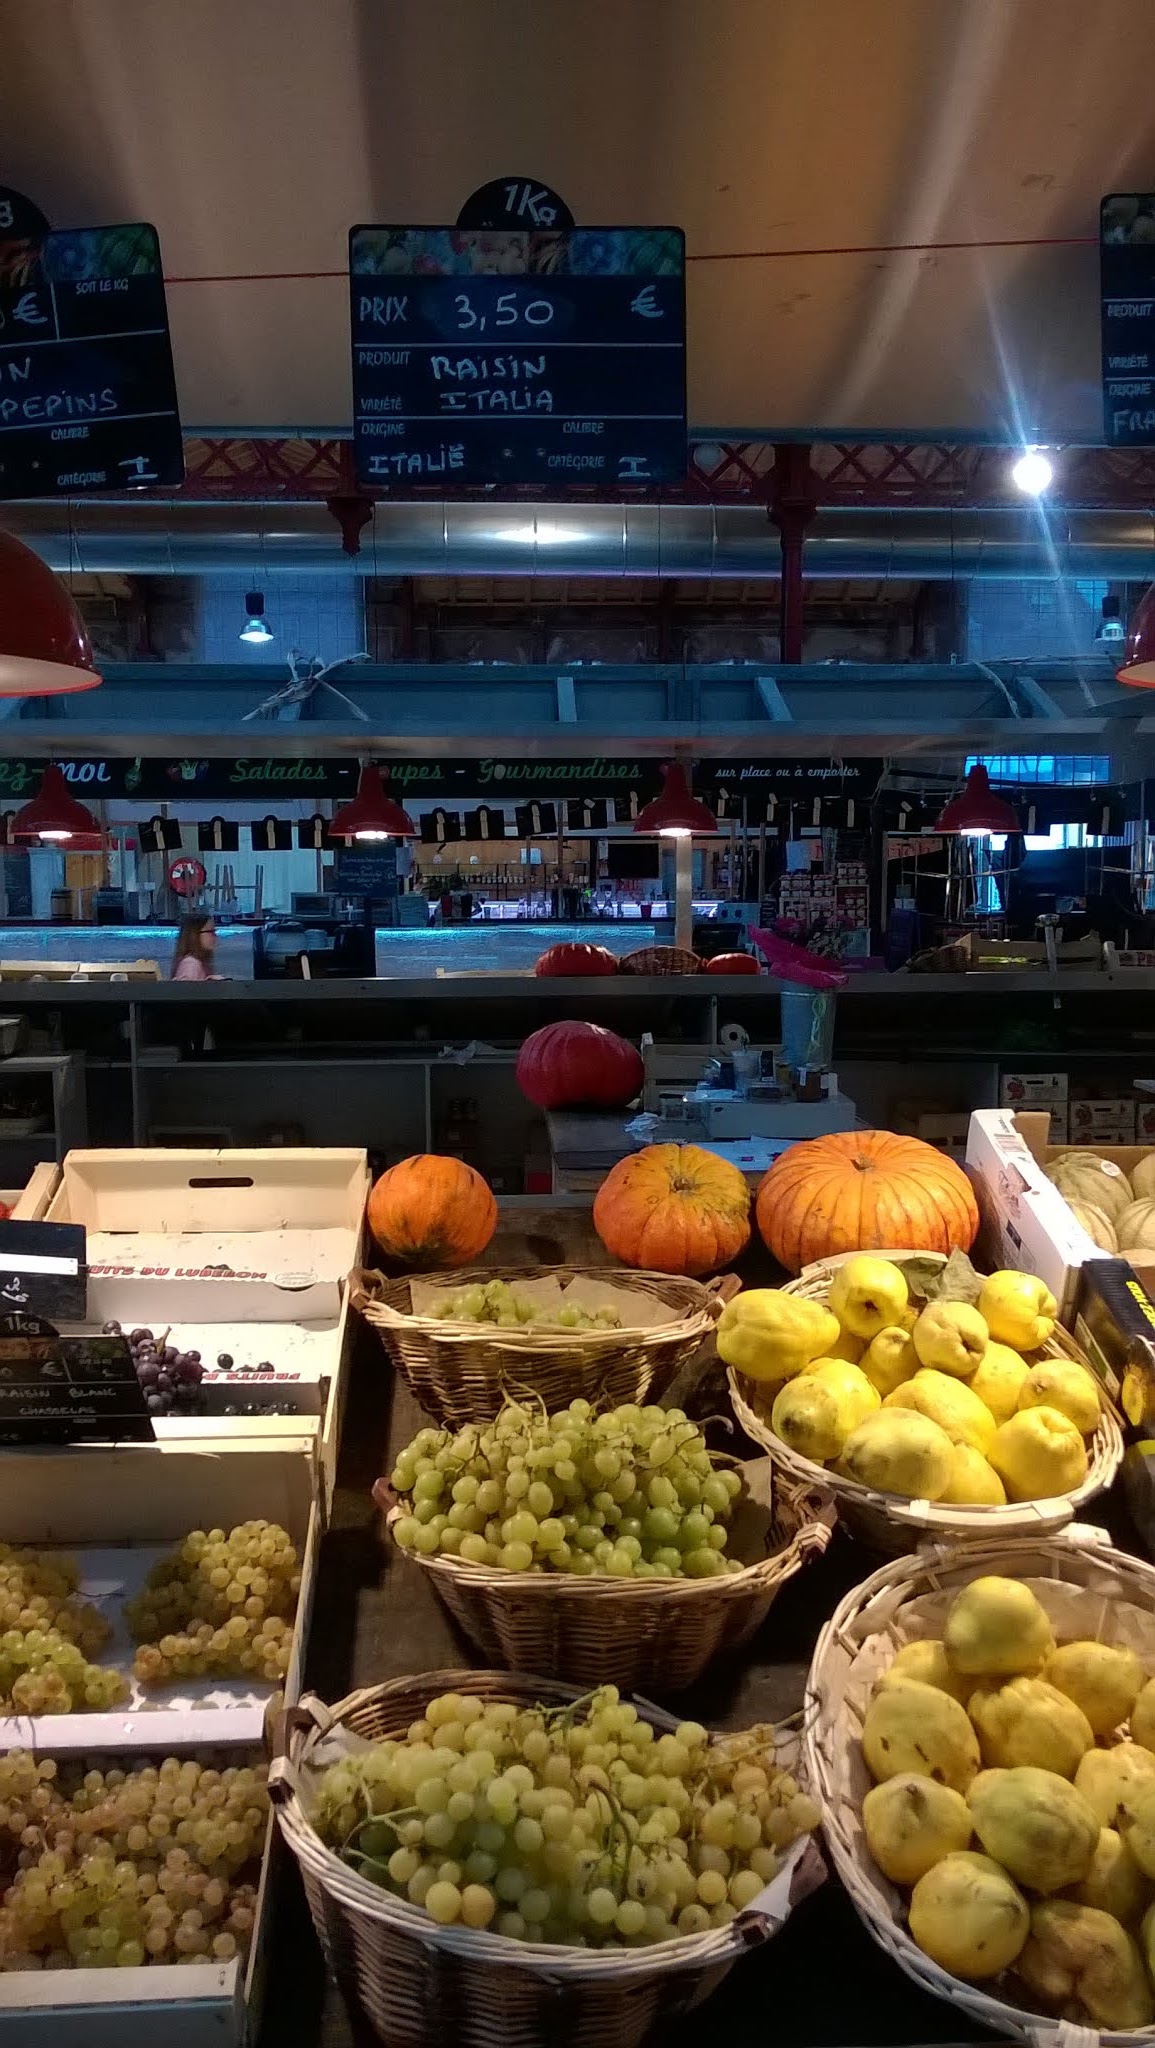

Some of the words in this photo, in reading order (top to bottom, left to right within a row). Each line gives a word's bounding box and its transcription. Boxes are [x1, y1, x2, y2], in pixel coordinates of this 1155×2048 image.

[76, 280, 97, 295] SOIT
[99, 279, 112, 293] LE
[113, 279, 129, 292] KG
[359, 295, 409, 326] PRIX
[454, 293, 554, 331] 3,50
[630, 285, 665, 318] €
[359, 350, 411, 367] PRODUIT
[360, 396, 403, 411] VARIÉTÉ
[50, 425, 91, 441] CALIBRE
[360, 422, 406, 437] ORIGINE
[562, 421, 605, 435] CALIBRE
[547, 454, 605, 469] CATÉGORIE
[57, 470, 107, 486] CATÉGORIE
[229, 759, 328, 783] Salades
[715, 768, 737, 778] sur
[739, 765, 772, 781] place
[775, 768, 790, 777] ou
[807, 765, 861, 781] emporter
[86, 1264, 135, 1276] UITS
[5, 1313, 41, 1335] 1kg
